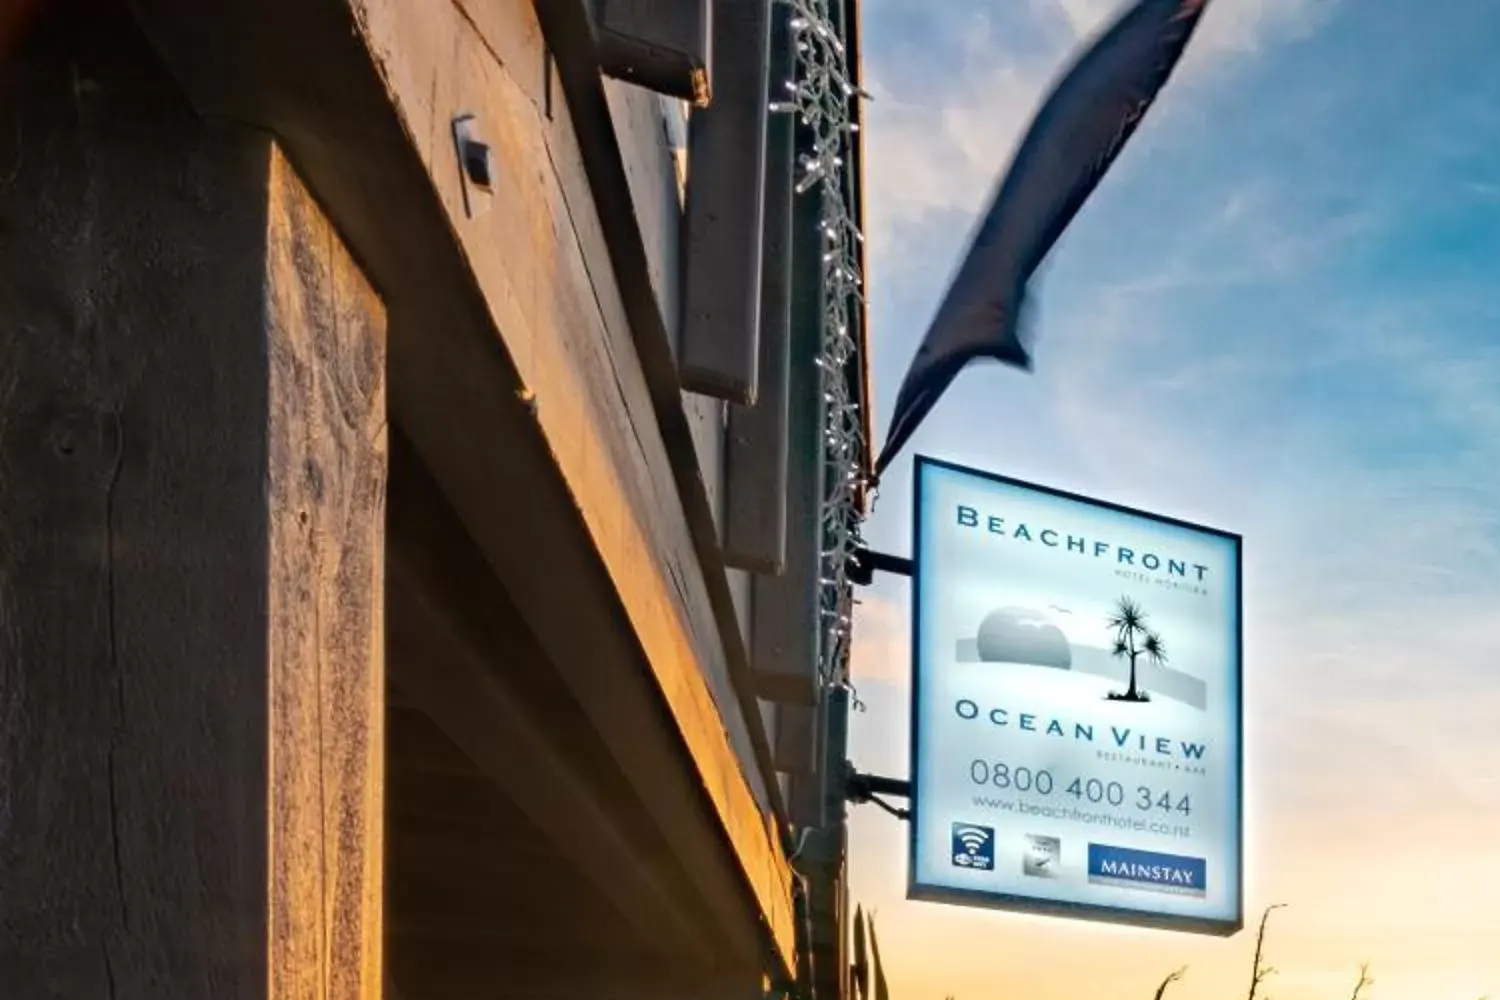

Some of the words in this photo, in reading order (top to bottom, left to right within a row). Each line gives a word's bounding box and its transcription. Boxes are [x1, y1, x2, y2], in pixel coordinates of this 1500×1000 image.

[956, 505, 1208, 580] BEACHFRONT
[955, 699, 1093, 741] OCEAN
[1111, 726, 1206, 760] VIEW
[970, 759, 1053, 795] 0800
[1065, 776, 1123, 806] 400
[1136, 786, 1192, 817] 344
[972, 796, 1191, 838] www.beachfronthotel.co.nz
[1101, 860, 1194, 885] MAINSTAY
